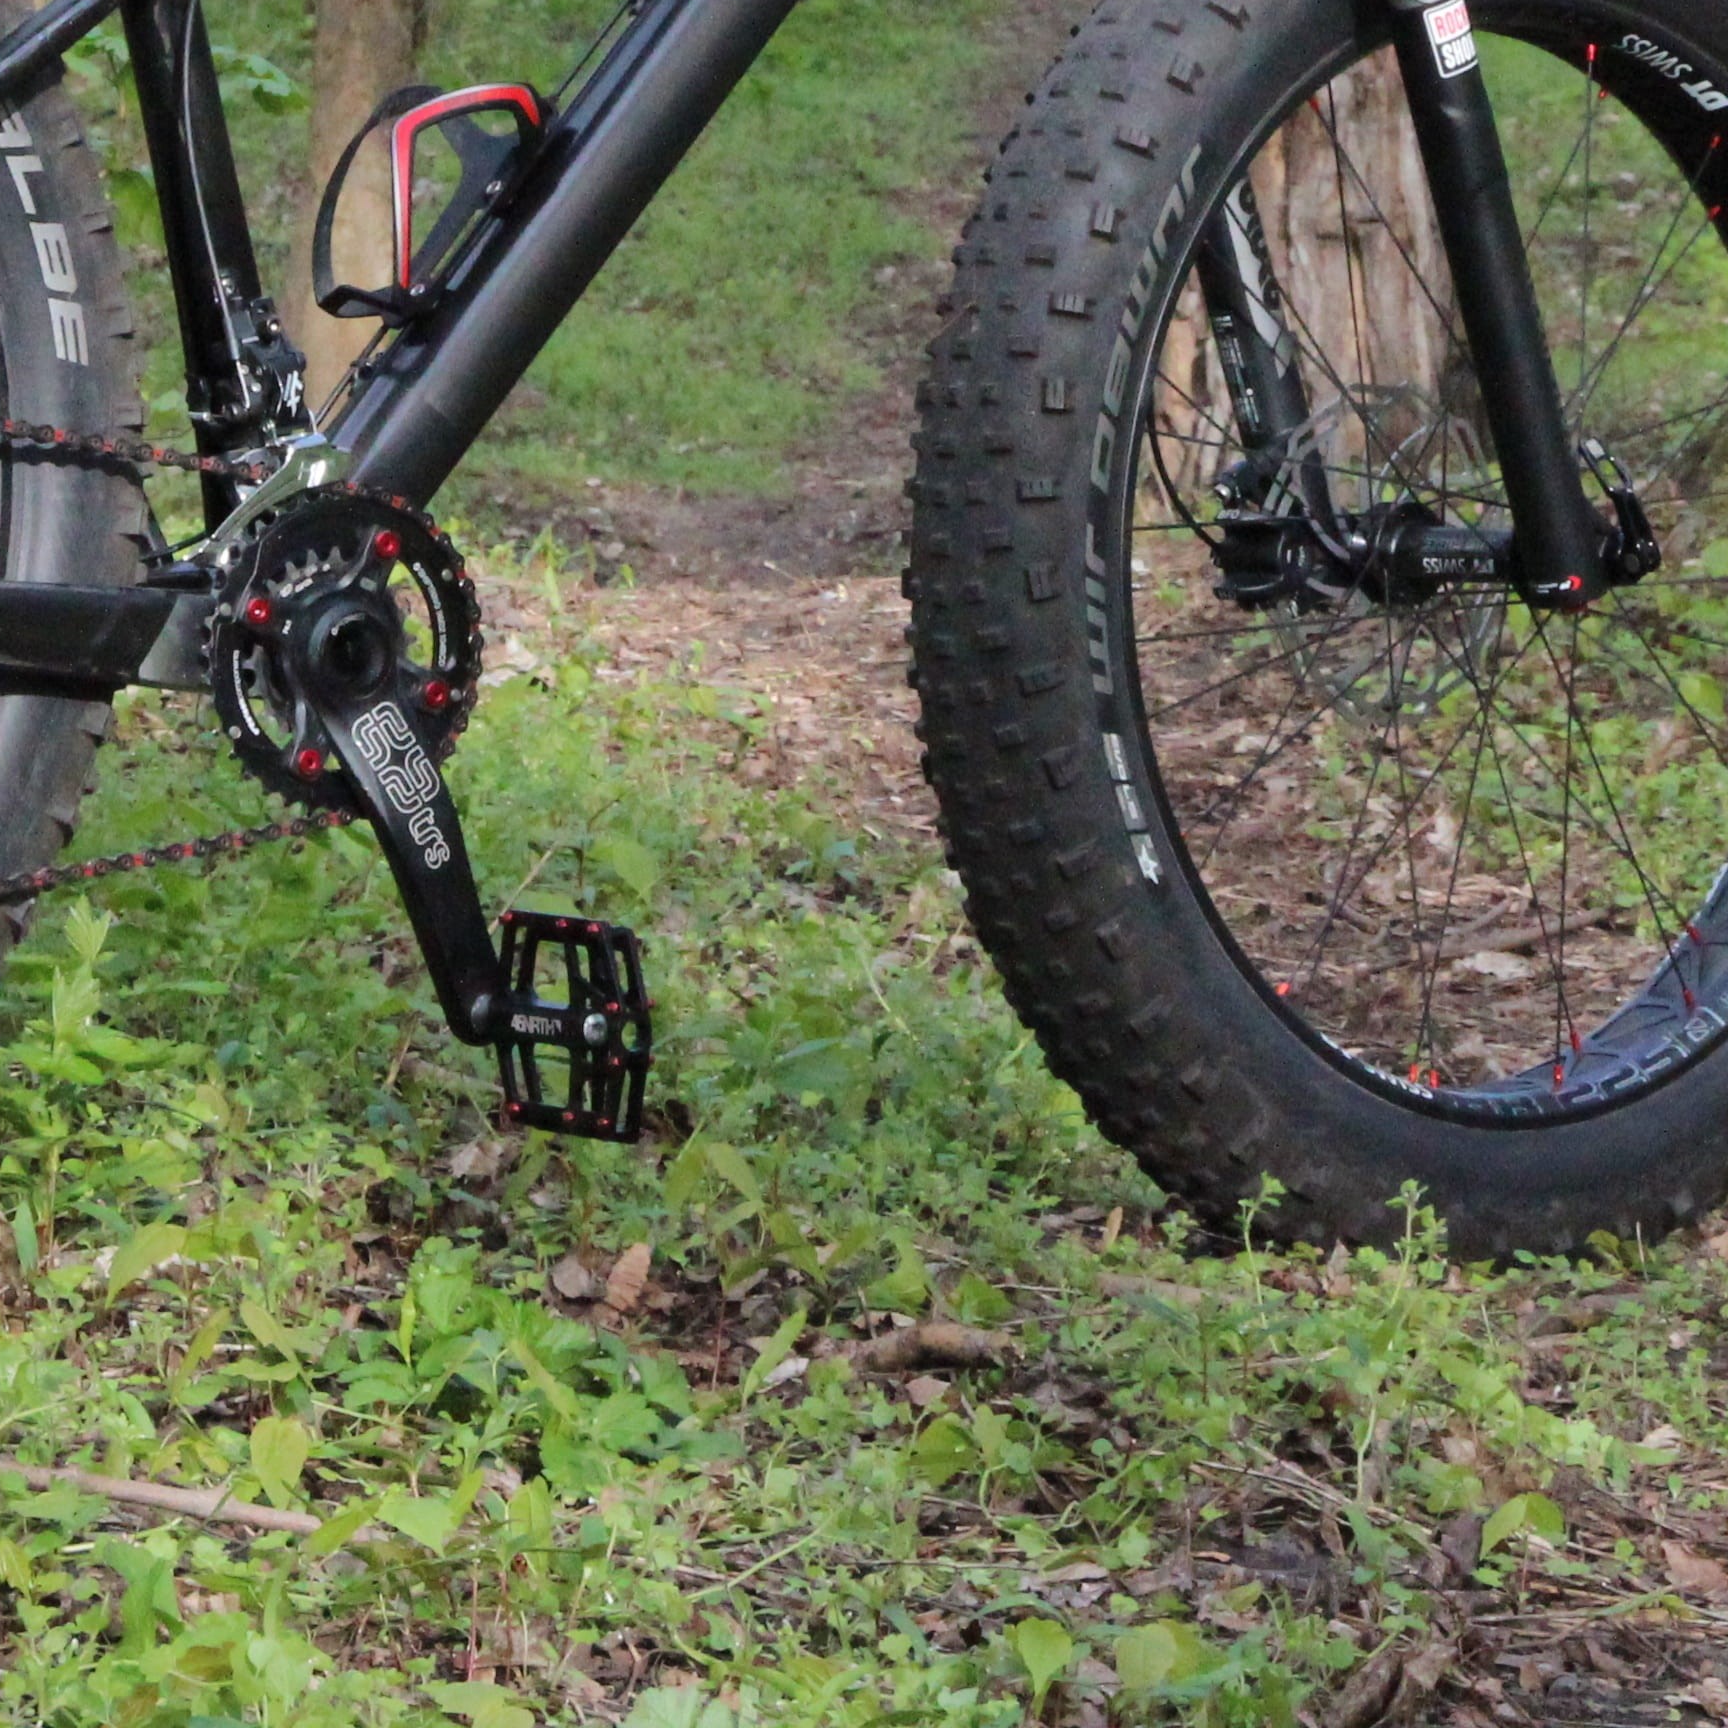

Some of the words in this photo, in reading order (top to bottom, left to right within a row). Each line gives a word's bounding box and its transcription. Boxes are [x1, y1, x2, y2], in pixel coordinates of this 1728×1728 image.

[1612, 34, 1693, 78] SWISS
[1090, 142, 1203, 495] JUMBO
[1084, 522, 1115, 695] JIM
